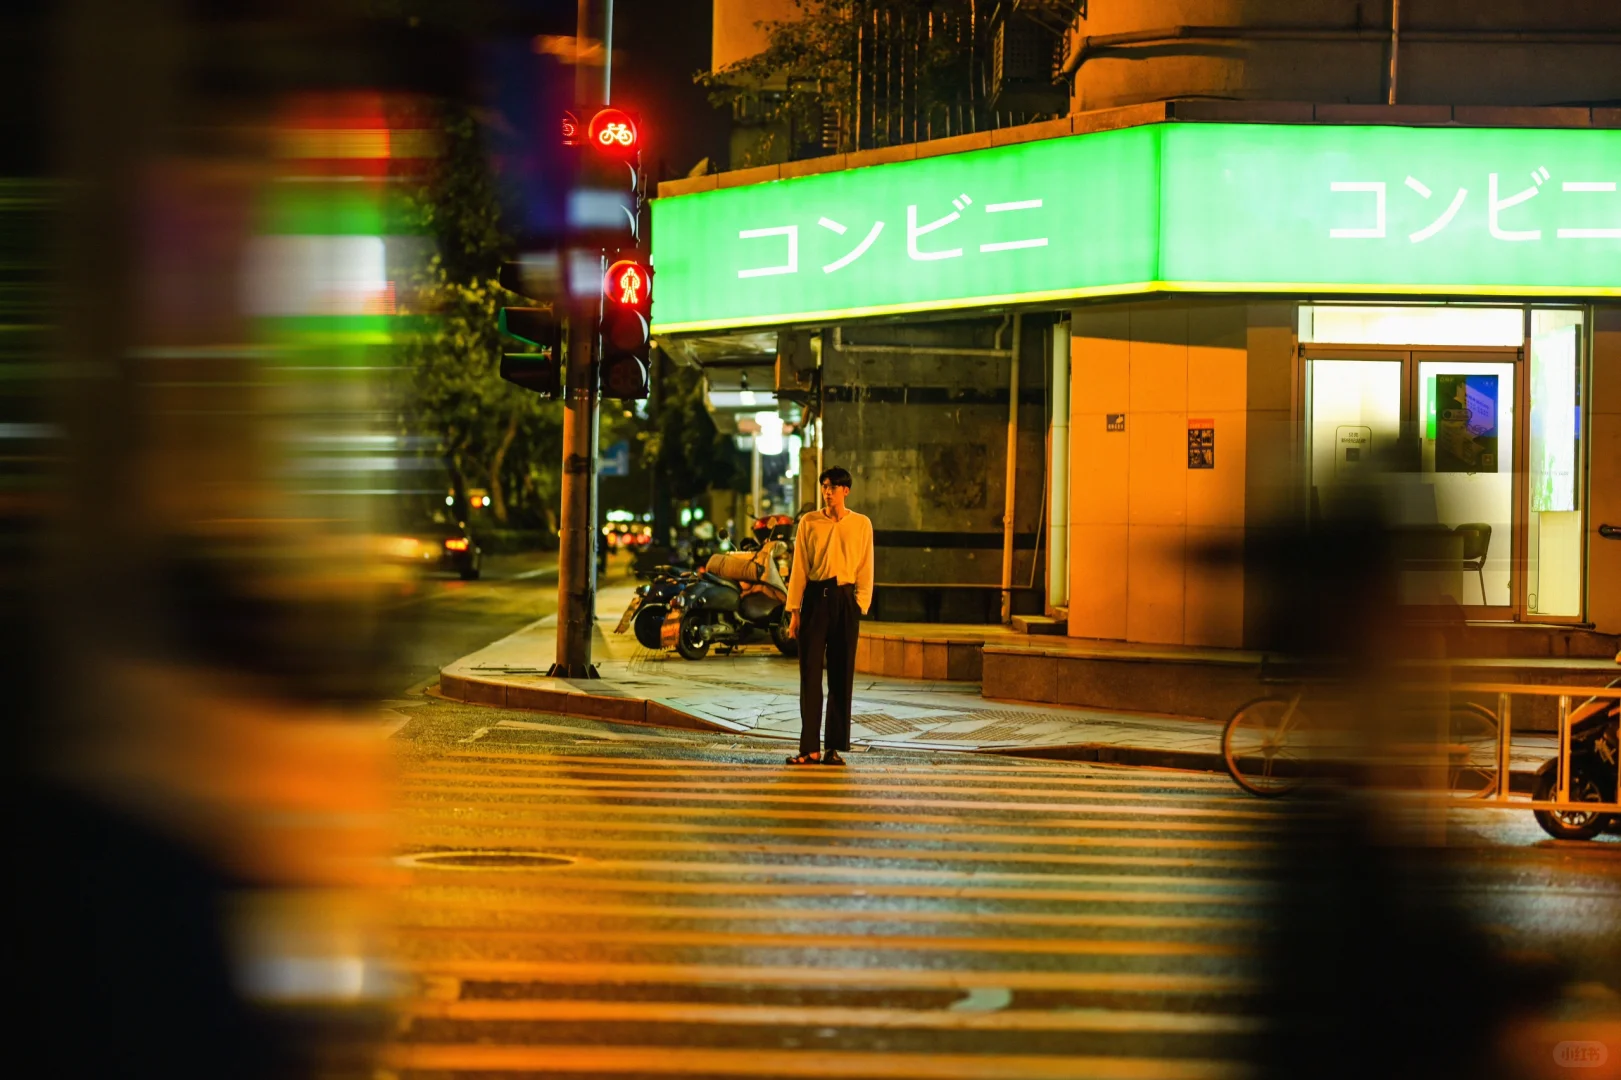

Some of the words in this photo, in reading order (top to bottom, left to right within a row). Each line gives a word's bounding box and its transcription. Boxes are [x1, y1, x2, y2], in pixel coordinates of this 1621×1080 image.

[737, 193, 1049, 278] コンビニ
[1329, 165, 1621, 244] コンビニ
